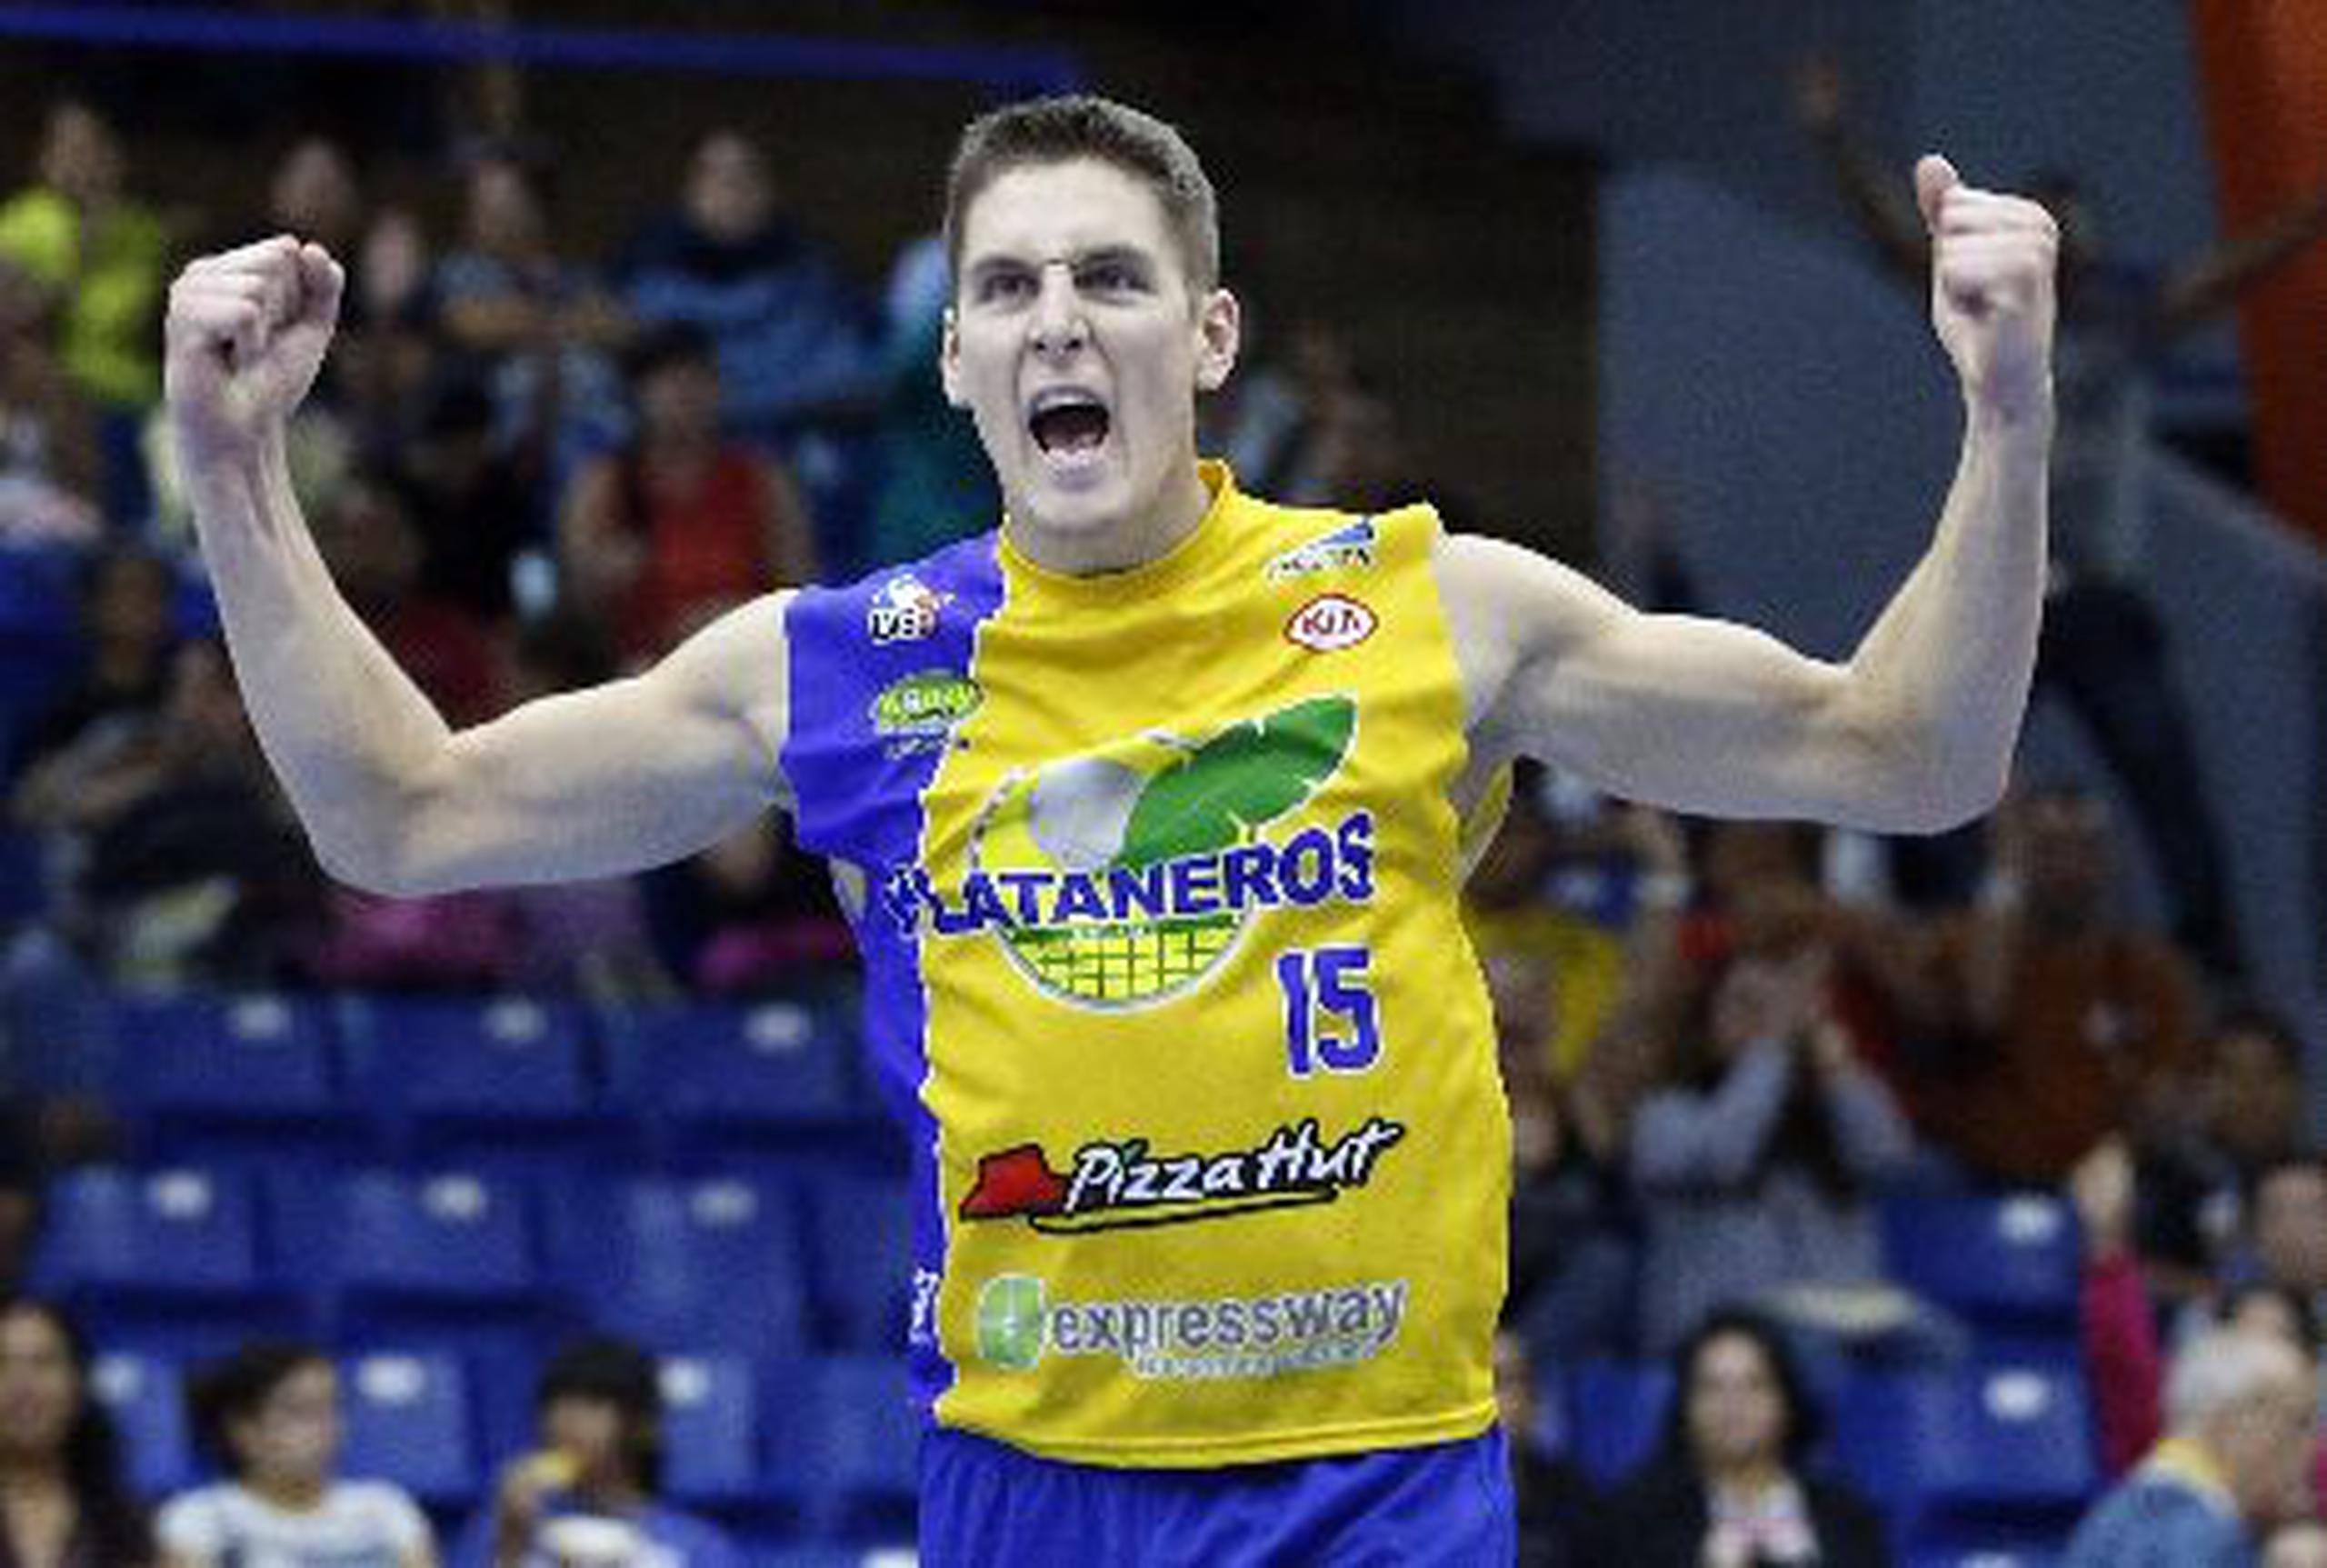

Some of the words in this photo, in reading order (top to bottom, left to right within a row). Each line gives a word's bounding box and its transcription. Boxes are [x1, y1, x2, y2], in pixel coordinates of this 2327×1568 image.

[1275, 945, 1383, 1078] 15
[1064, 1138, 1248, 1216] Pizza
[1252, 1116, 1405, 1189] Hut
[1051, 1279, 1405, 1358] expressway
